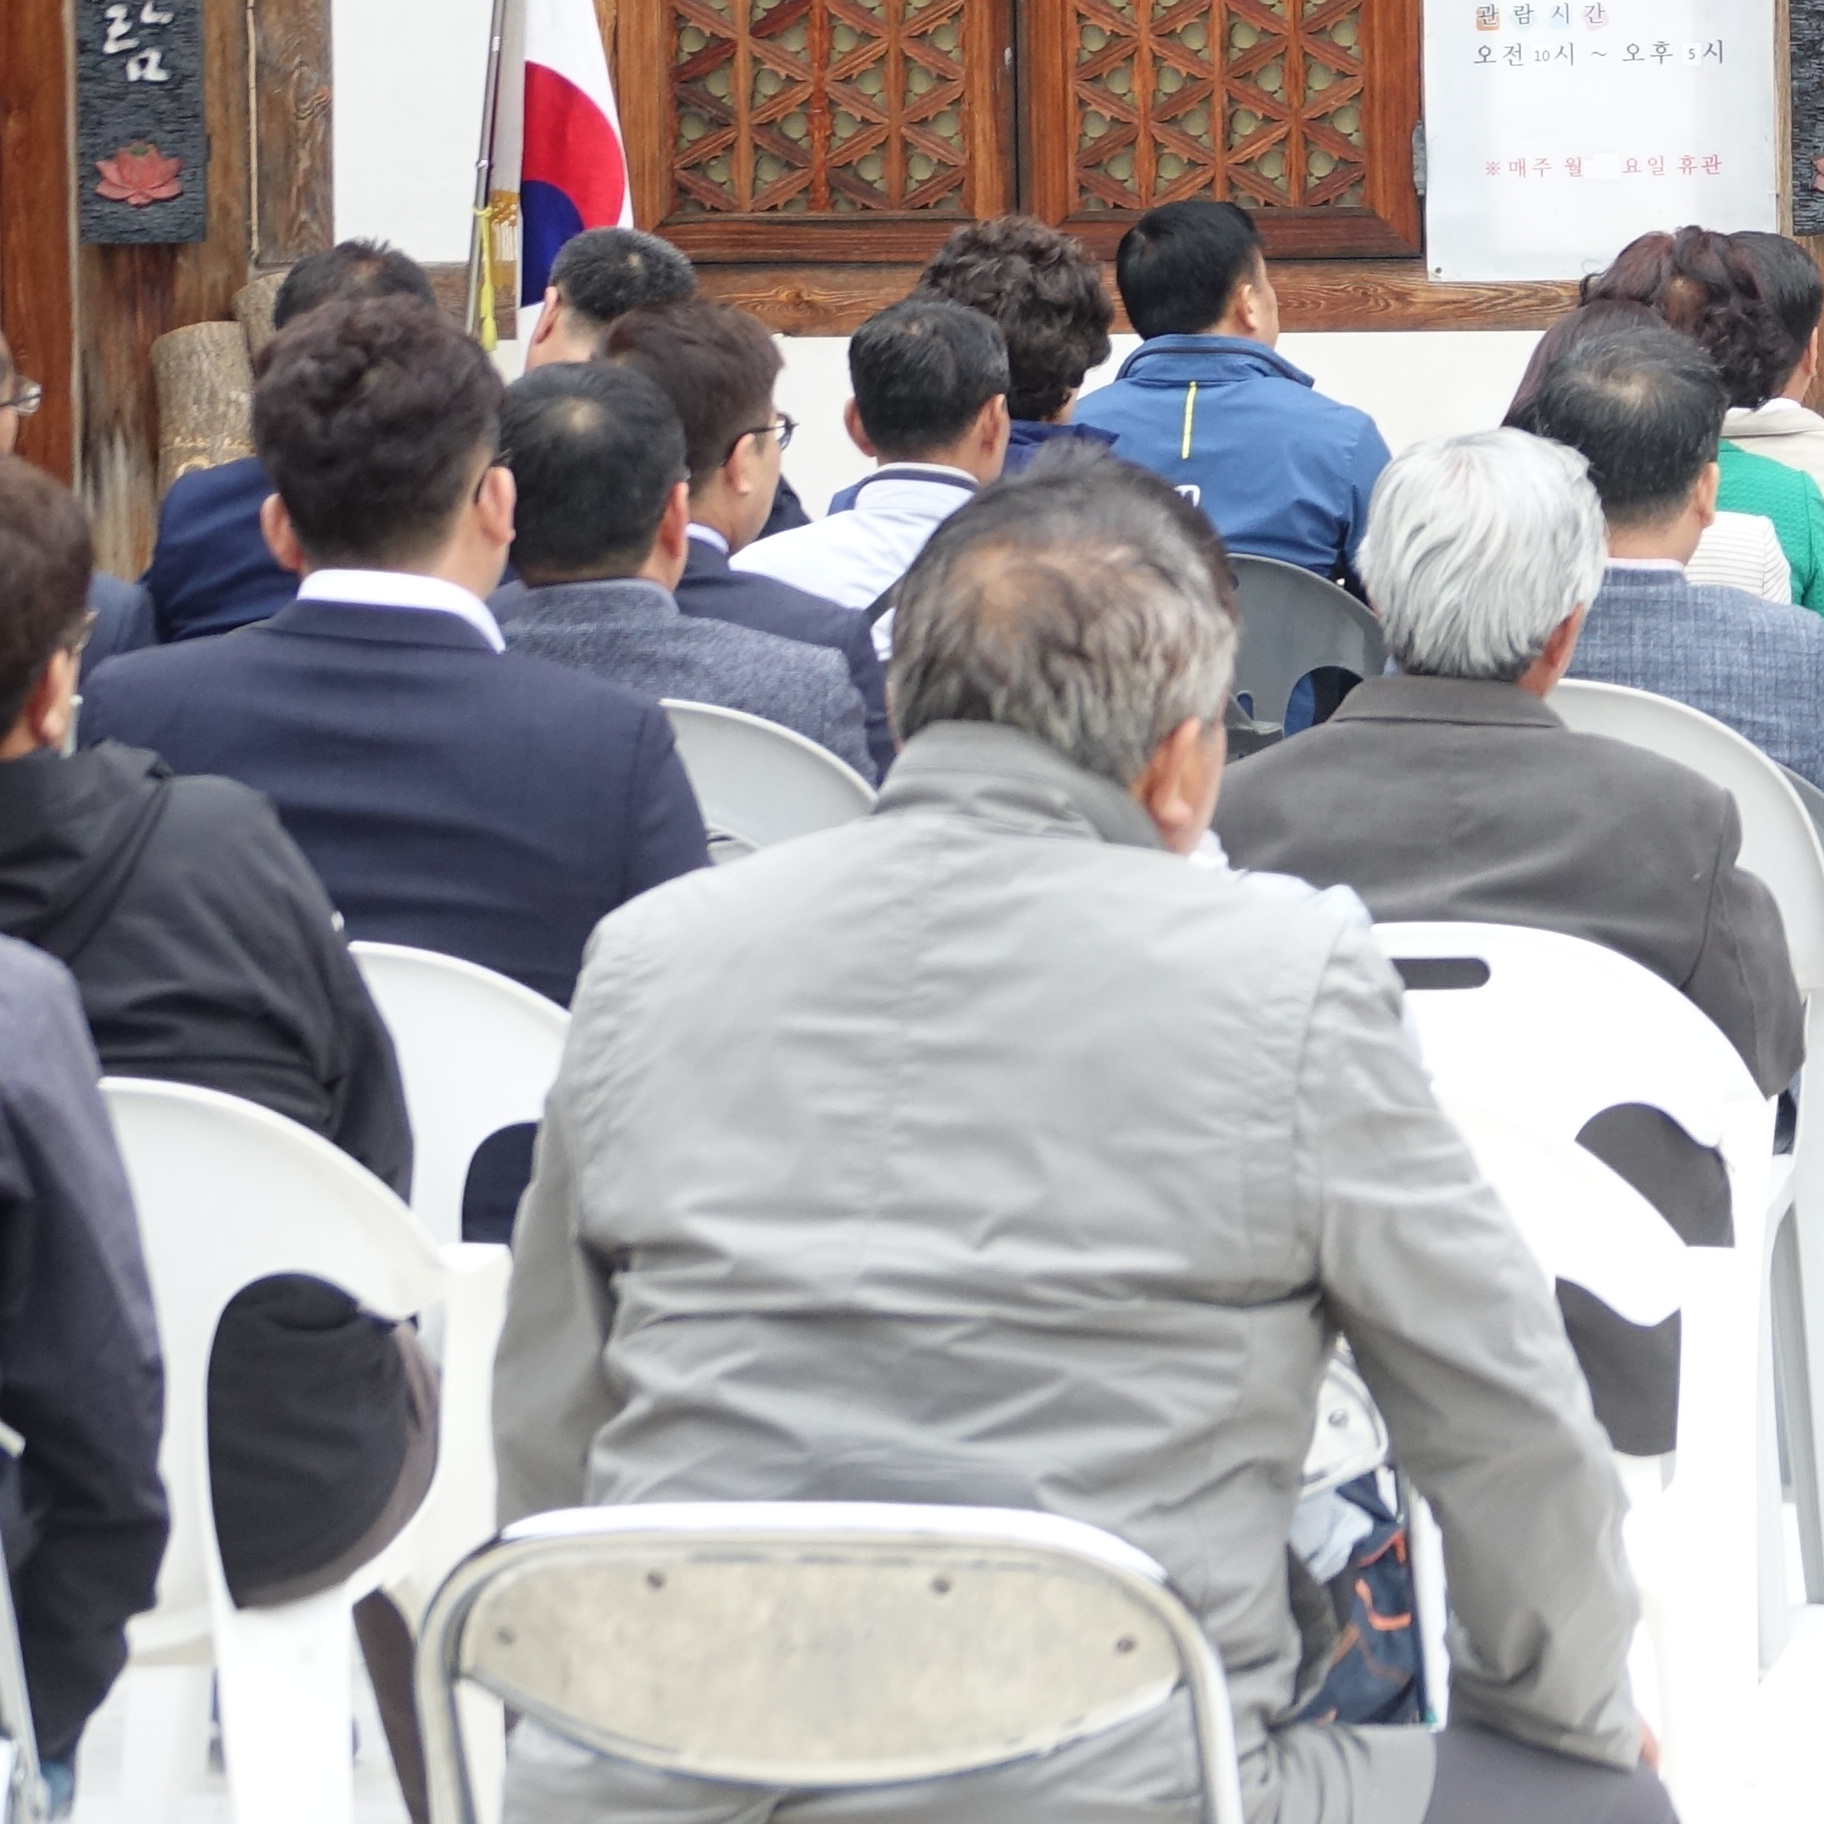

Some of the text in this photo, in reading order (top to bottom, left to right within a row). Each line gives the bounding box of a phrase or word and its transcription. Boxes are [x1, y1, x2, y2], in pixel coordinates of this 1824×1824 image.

[1473, 42, 1524, 67] 오전
[1621, 40, 1673, 65] 오후
[1621, 155, 1666, 176] 요일
[1677, 153, 1723, 176] 휴관
